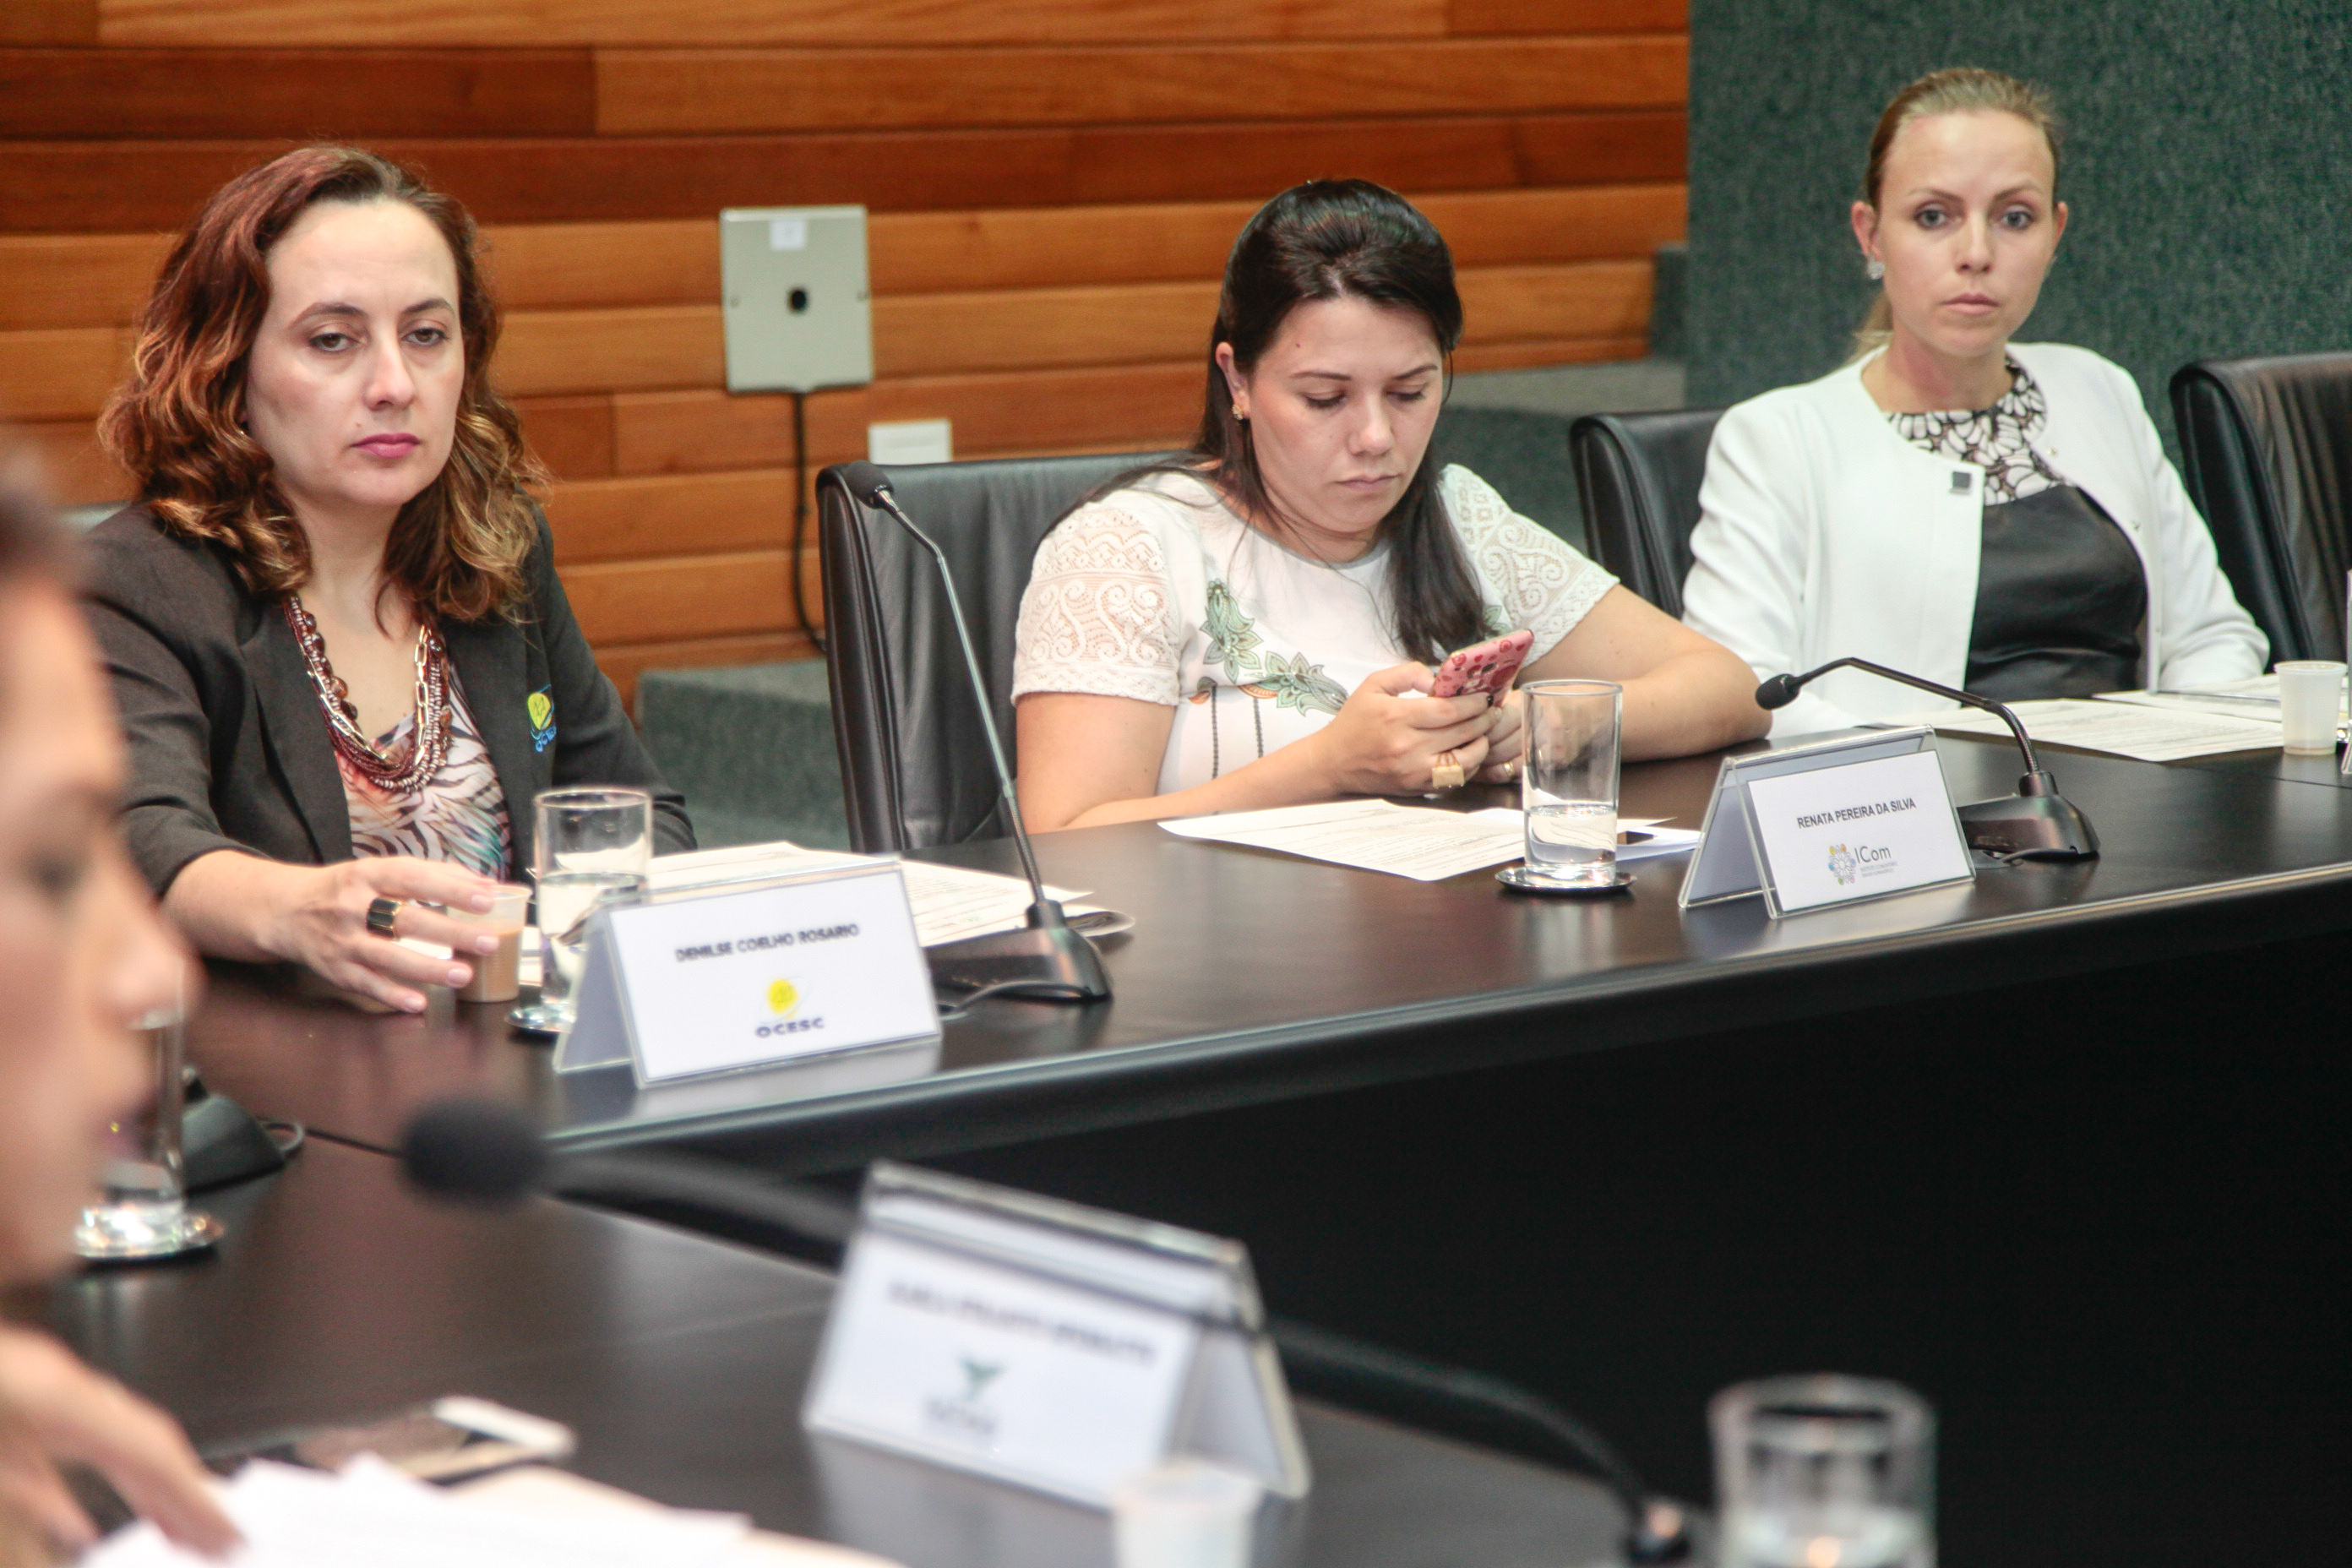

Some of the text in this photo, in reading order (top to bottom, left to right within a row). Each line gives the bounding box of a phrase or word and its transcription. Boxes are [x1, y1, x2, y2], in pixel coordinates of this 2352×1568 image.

[1796, 798, 1917, 829] RENATA PEREIRA DA SILVA
[1854, 846, 1892, 863] ICom
[737, 933, 794, 954] COELHO
[798, 923, 859, 945] ROSARIO
[755, 1016, 825, 1038] OCESC
